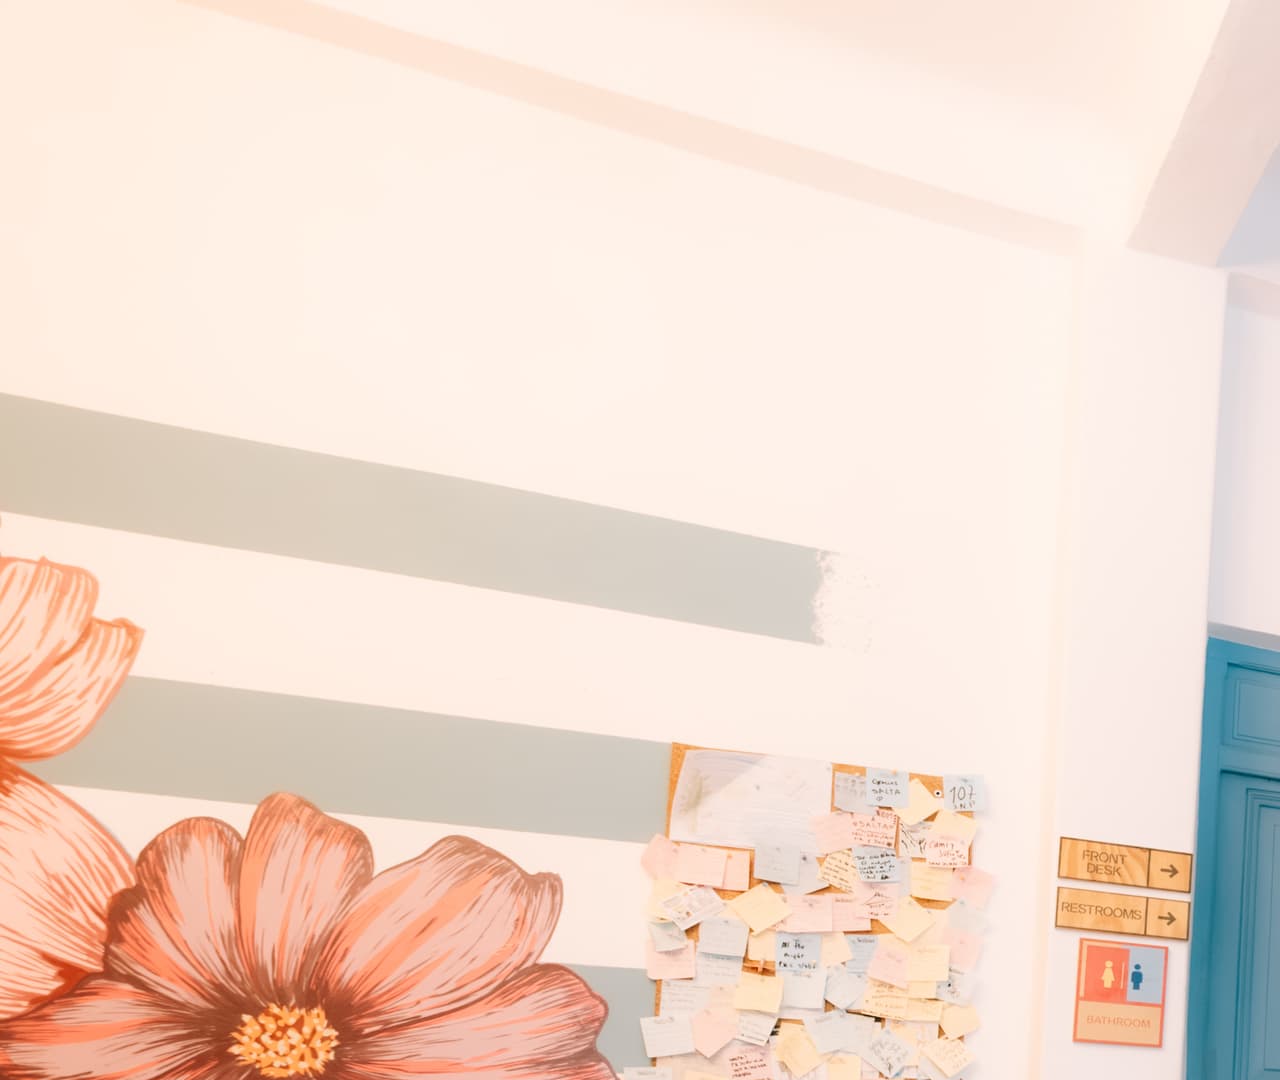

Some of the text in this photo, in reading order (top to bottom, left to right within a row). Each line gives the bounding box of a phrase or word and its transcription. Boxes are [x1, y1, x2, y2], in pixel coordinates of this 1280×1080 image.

[1082, 849, 1128, 866] FRONT
[1086, 862, 1122, 877] DESK
[1061, 902, 1143, 921] RESTROOMS
[1086, 1015, 1151, 1029] BATHROOM
